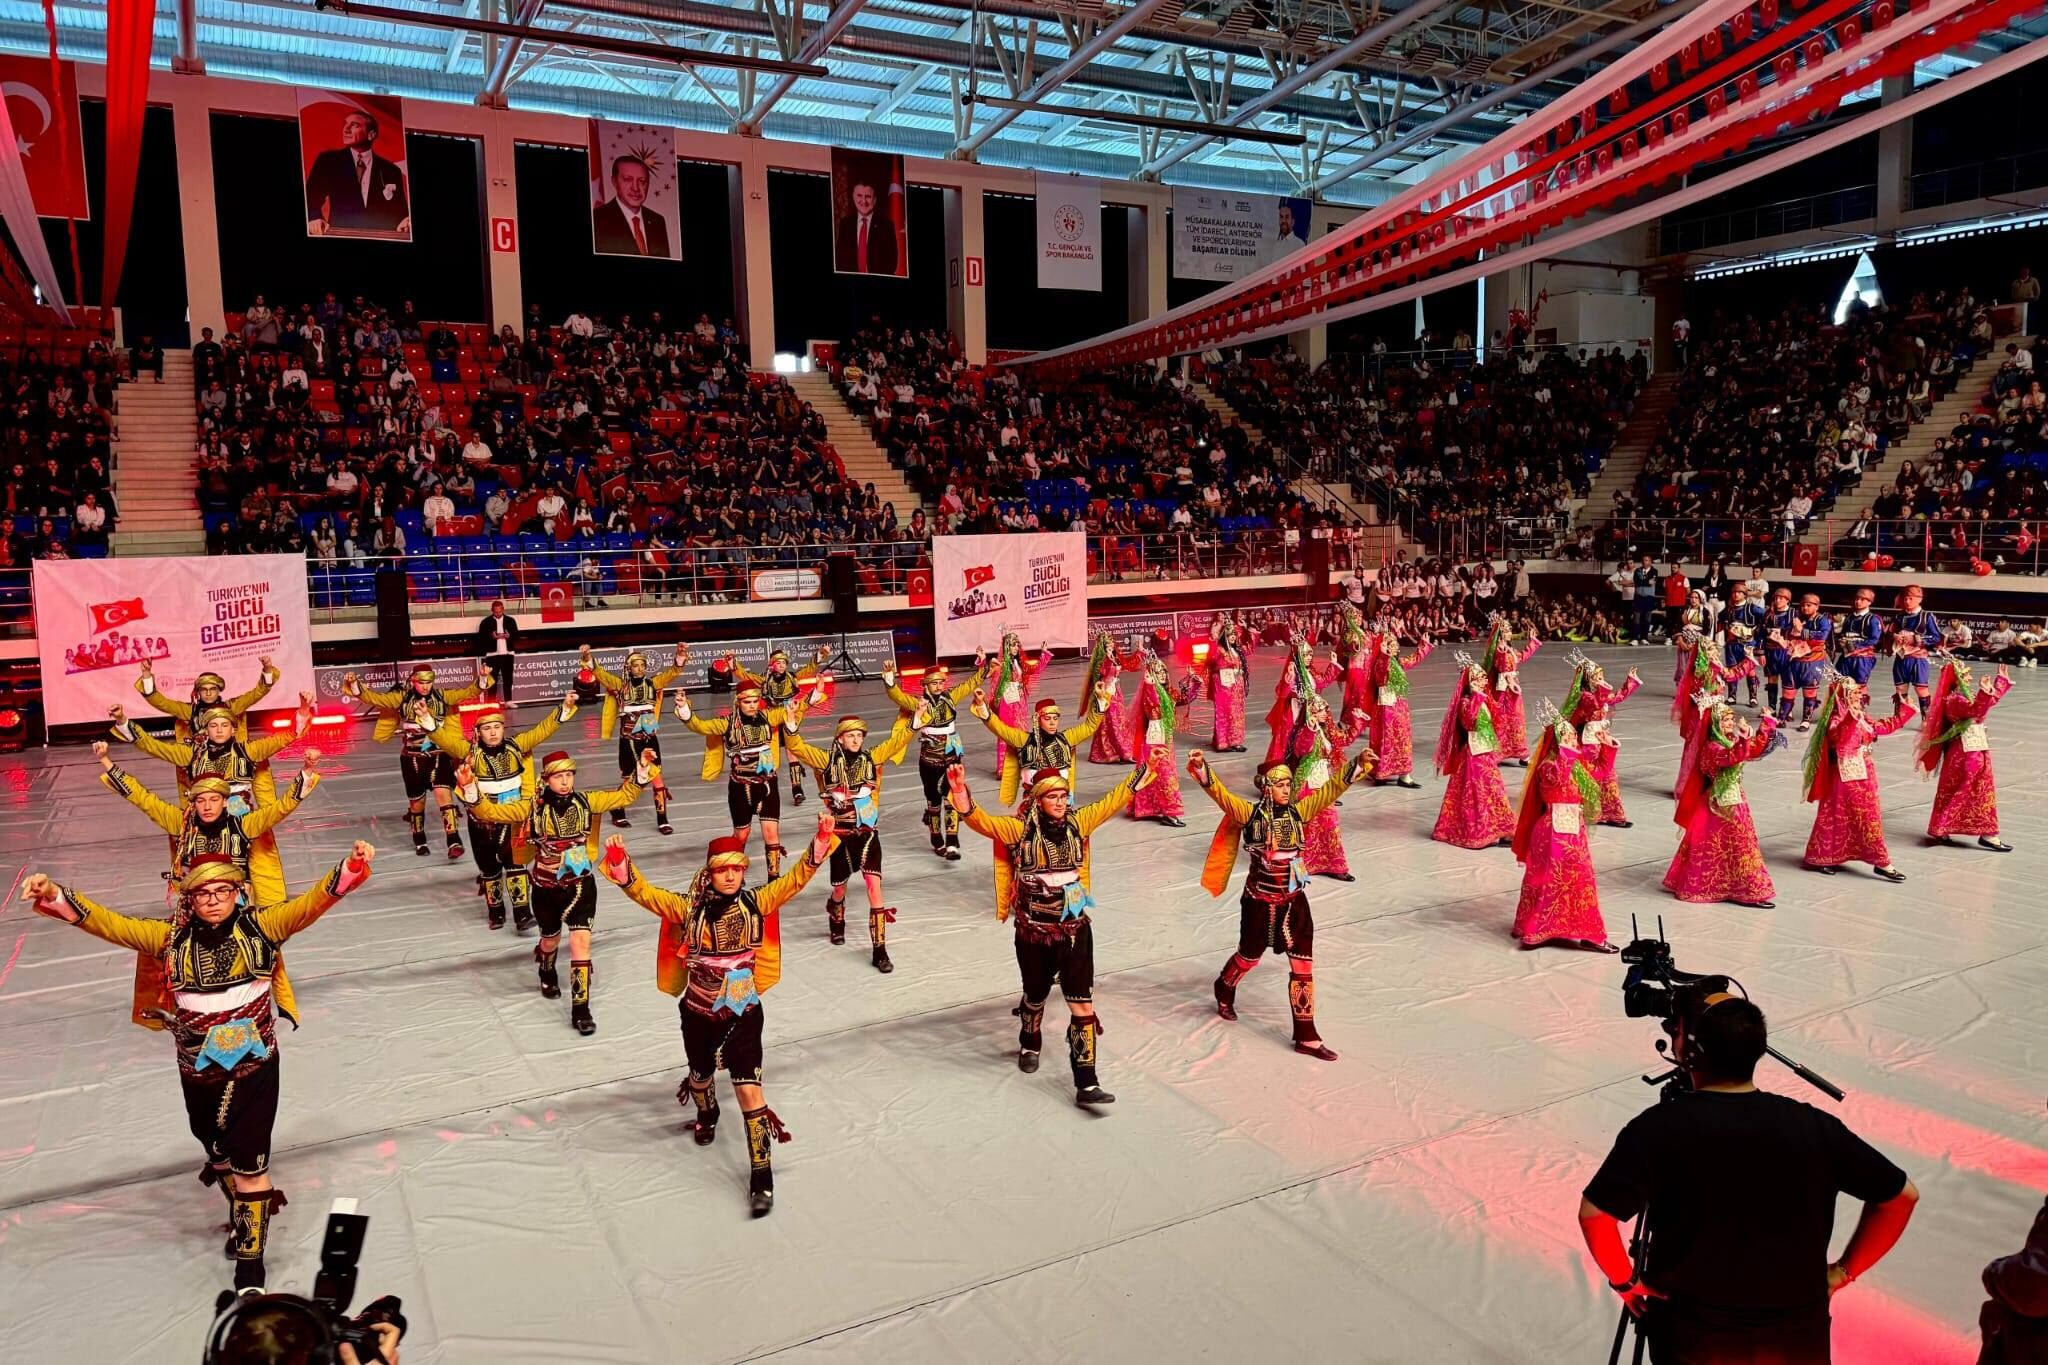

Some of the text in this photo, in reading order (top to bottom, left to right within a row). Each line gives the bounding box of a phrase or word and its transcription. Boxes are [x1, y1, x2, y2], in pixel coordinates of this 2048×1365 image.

[1185, 215, 1263, 230] MÜSABAKALARA KATILAN
[497, 221, 511, 250] C
[1186, 224, 1200, 233] TÜM
[1229, 229, 1263, 239] ANTRENÖR
[1202, 236, 1256, 247] SPORCULARIMIZA
[1046, 250, 1062, 258] SPOR
[1192, 244, 1257, 257] BAŞARILAR DİLERİM
[969, 259, 980, 284] D
[1033, 564, 1061, 582] GÜCÜ
[215, 597, 264, 621] GÜCÜ
[200, 613, 281, 645] GENÇLİĞİ
[526, 659, 557, 670] GENÇLİK
[558, 659, 568, 667] VE
